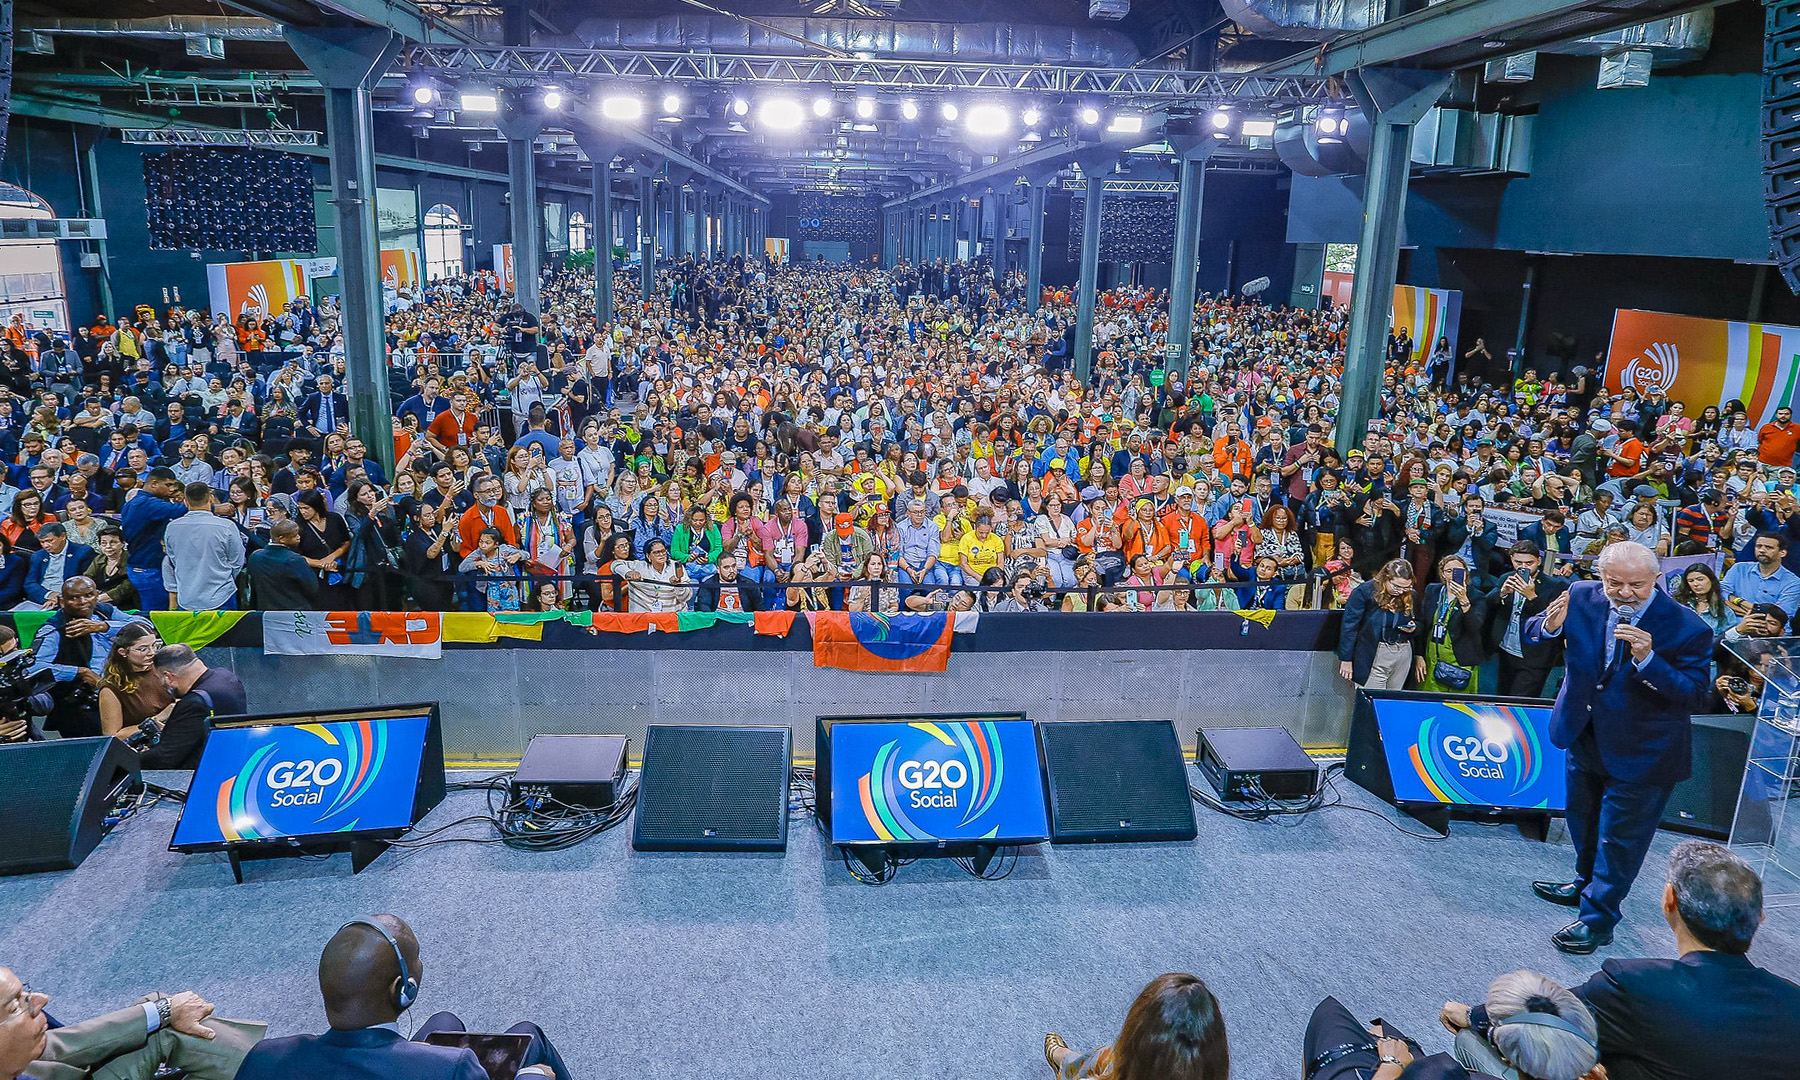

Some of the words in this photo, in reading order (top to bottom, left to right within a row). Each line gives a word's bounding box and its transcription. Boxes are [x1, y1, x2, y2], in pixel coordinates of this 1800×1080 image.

[1635, 366, 1662, 382] G20
[1443, 735, 1509, 763] G20
[266, 758, 343, 789] G20
[898, 760, 968, 789] G20
[1458, 762, 1505, 779] Social
[270, 787, 325, 807] Social
[910, 789, 957, 808] Social
